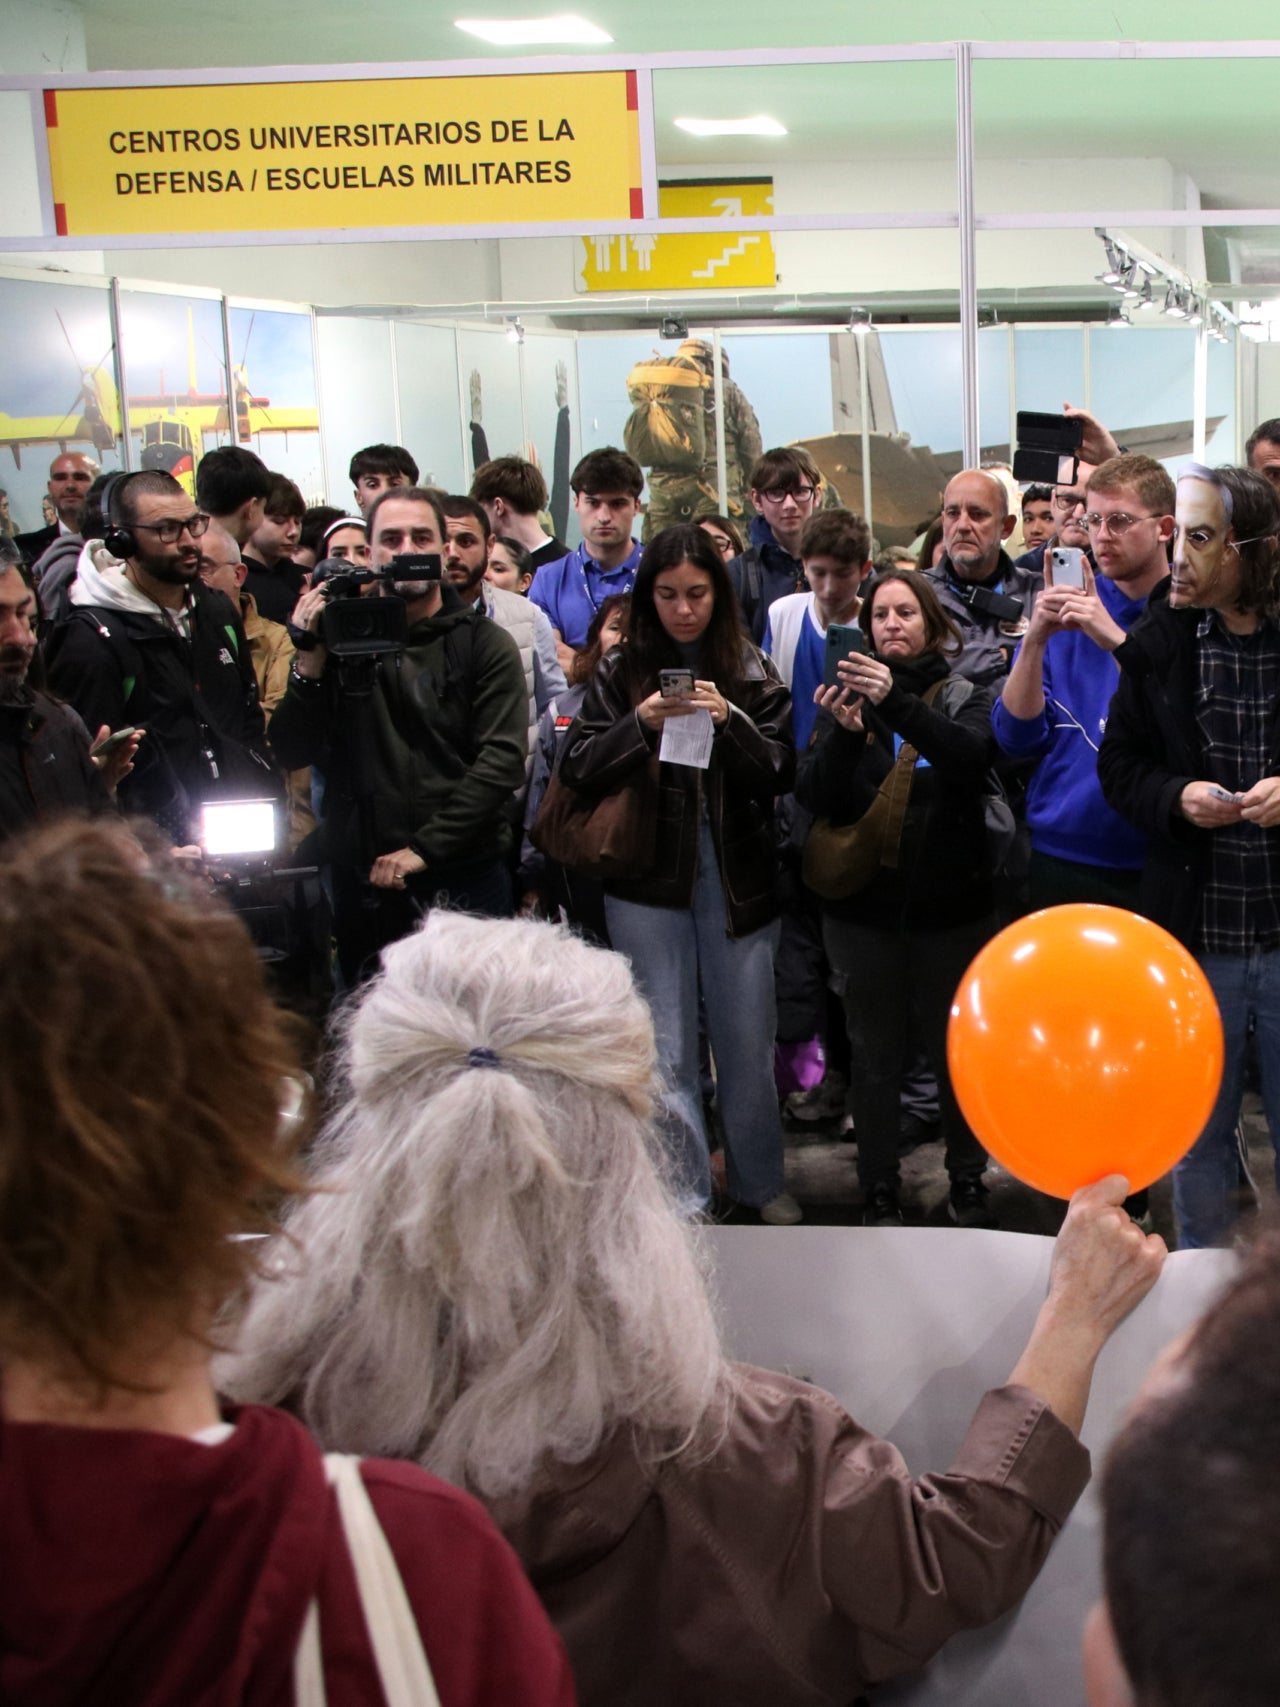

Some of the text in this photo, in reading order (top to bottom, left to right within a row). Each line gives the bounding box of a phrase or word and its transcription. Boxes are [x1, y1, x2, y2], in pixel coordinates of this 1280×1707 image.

[109, 118, 576, 155] CENTROS UNIVERSITARIOS DE LA
[115, 160, 573, 196] DEFENSA / ESCUELAS MILITARES
